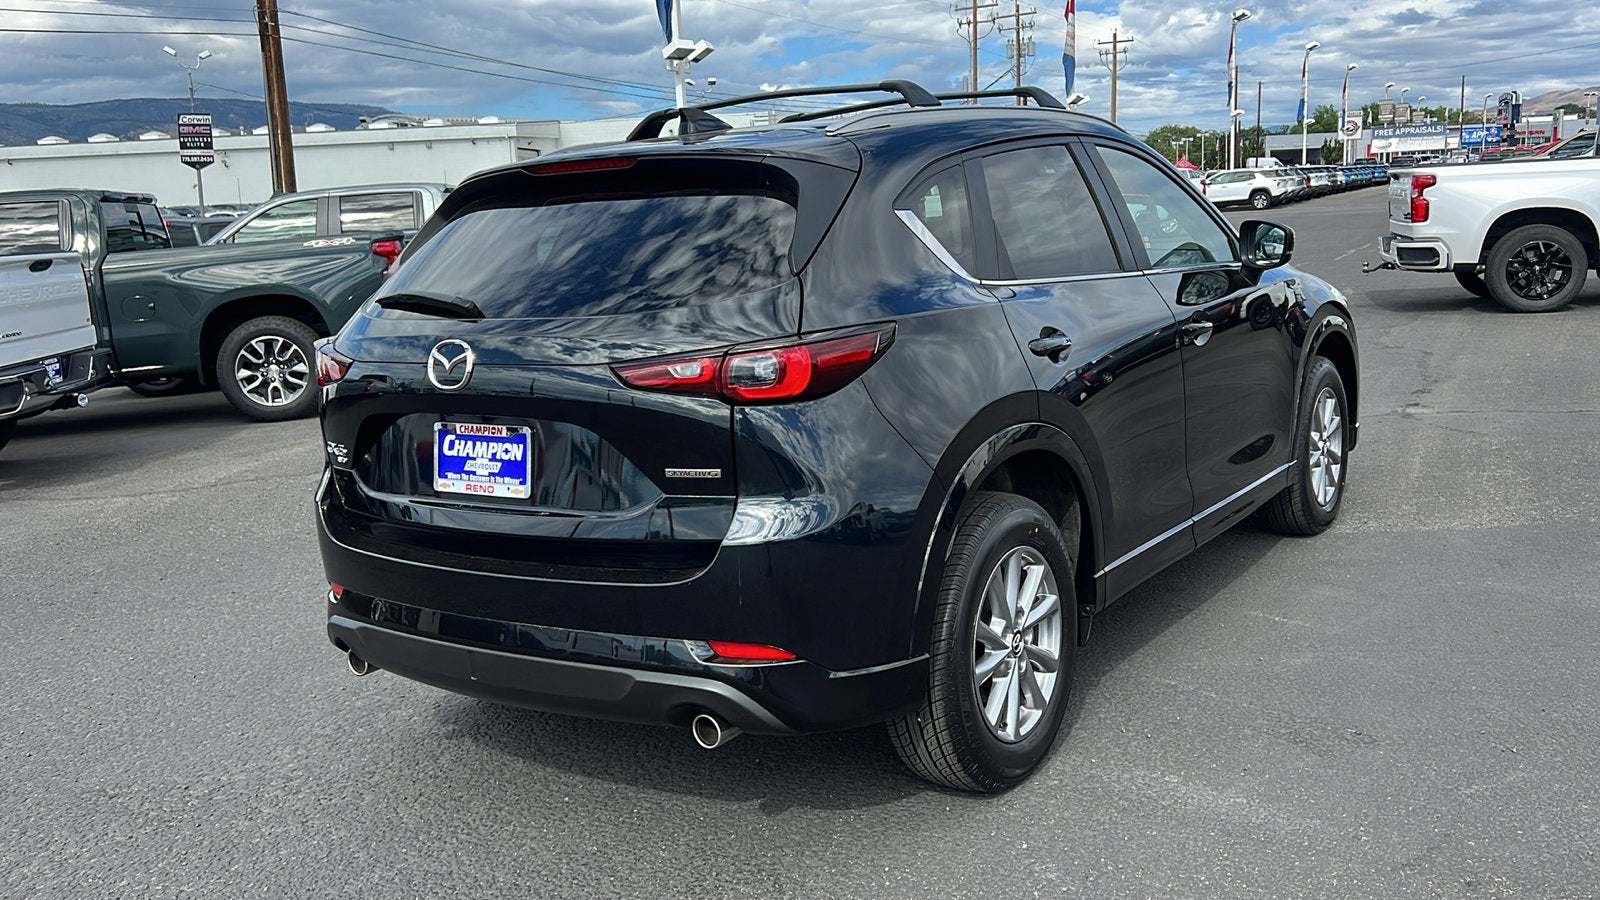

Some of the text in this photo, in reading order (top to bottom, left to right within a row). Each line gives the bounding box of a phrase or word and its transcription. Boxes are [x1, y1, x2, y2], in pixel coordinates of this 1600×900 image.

[1374, 125, 1444, 137] FREE APPRAISALS!
[459, 424, 503, 436] CHAMPION
[442, 434, 524, 461] CHAMPION
[467, 461, 499, 471] CHEVROLET
[465, 483, 495, 494] RENO
